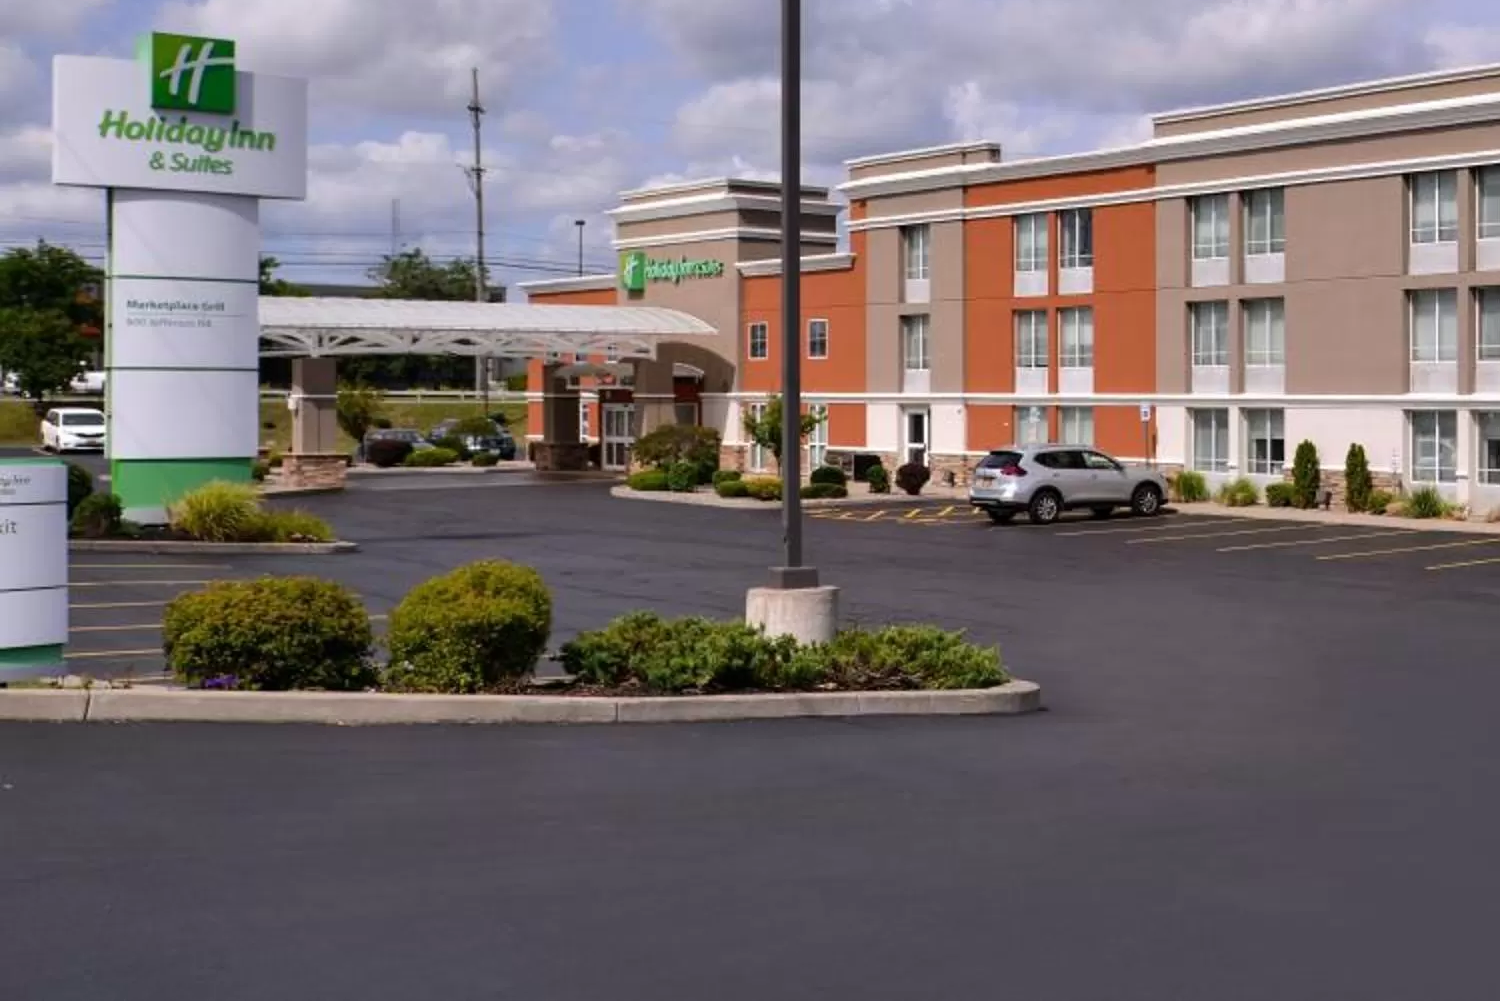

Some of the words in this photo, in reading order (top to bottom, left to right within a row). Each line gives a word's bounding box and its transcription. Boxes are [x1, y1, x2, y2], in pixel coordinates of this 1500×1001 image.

[98, 109, 226, 152] Holiday
[228, 119, 276, 150] Inn
[149, 151, 165, 170] &
[170, 152, 233, 175] Suites
[126, 299, 199, 311] Marketplace
